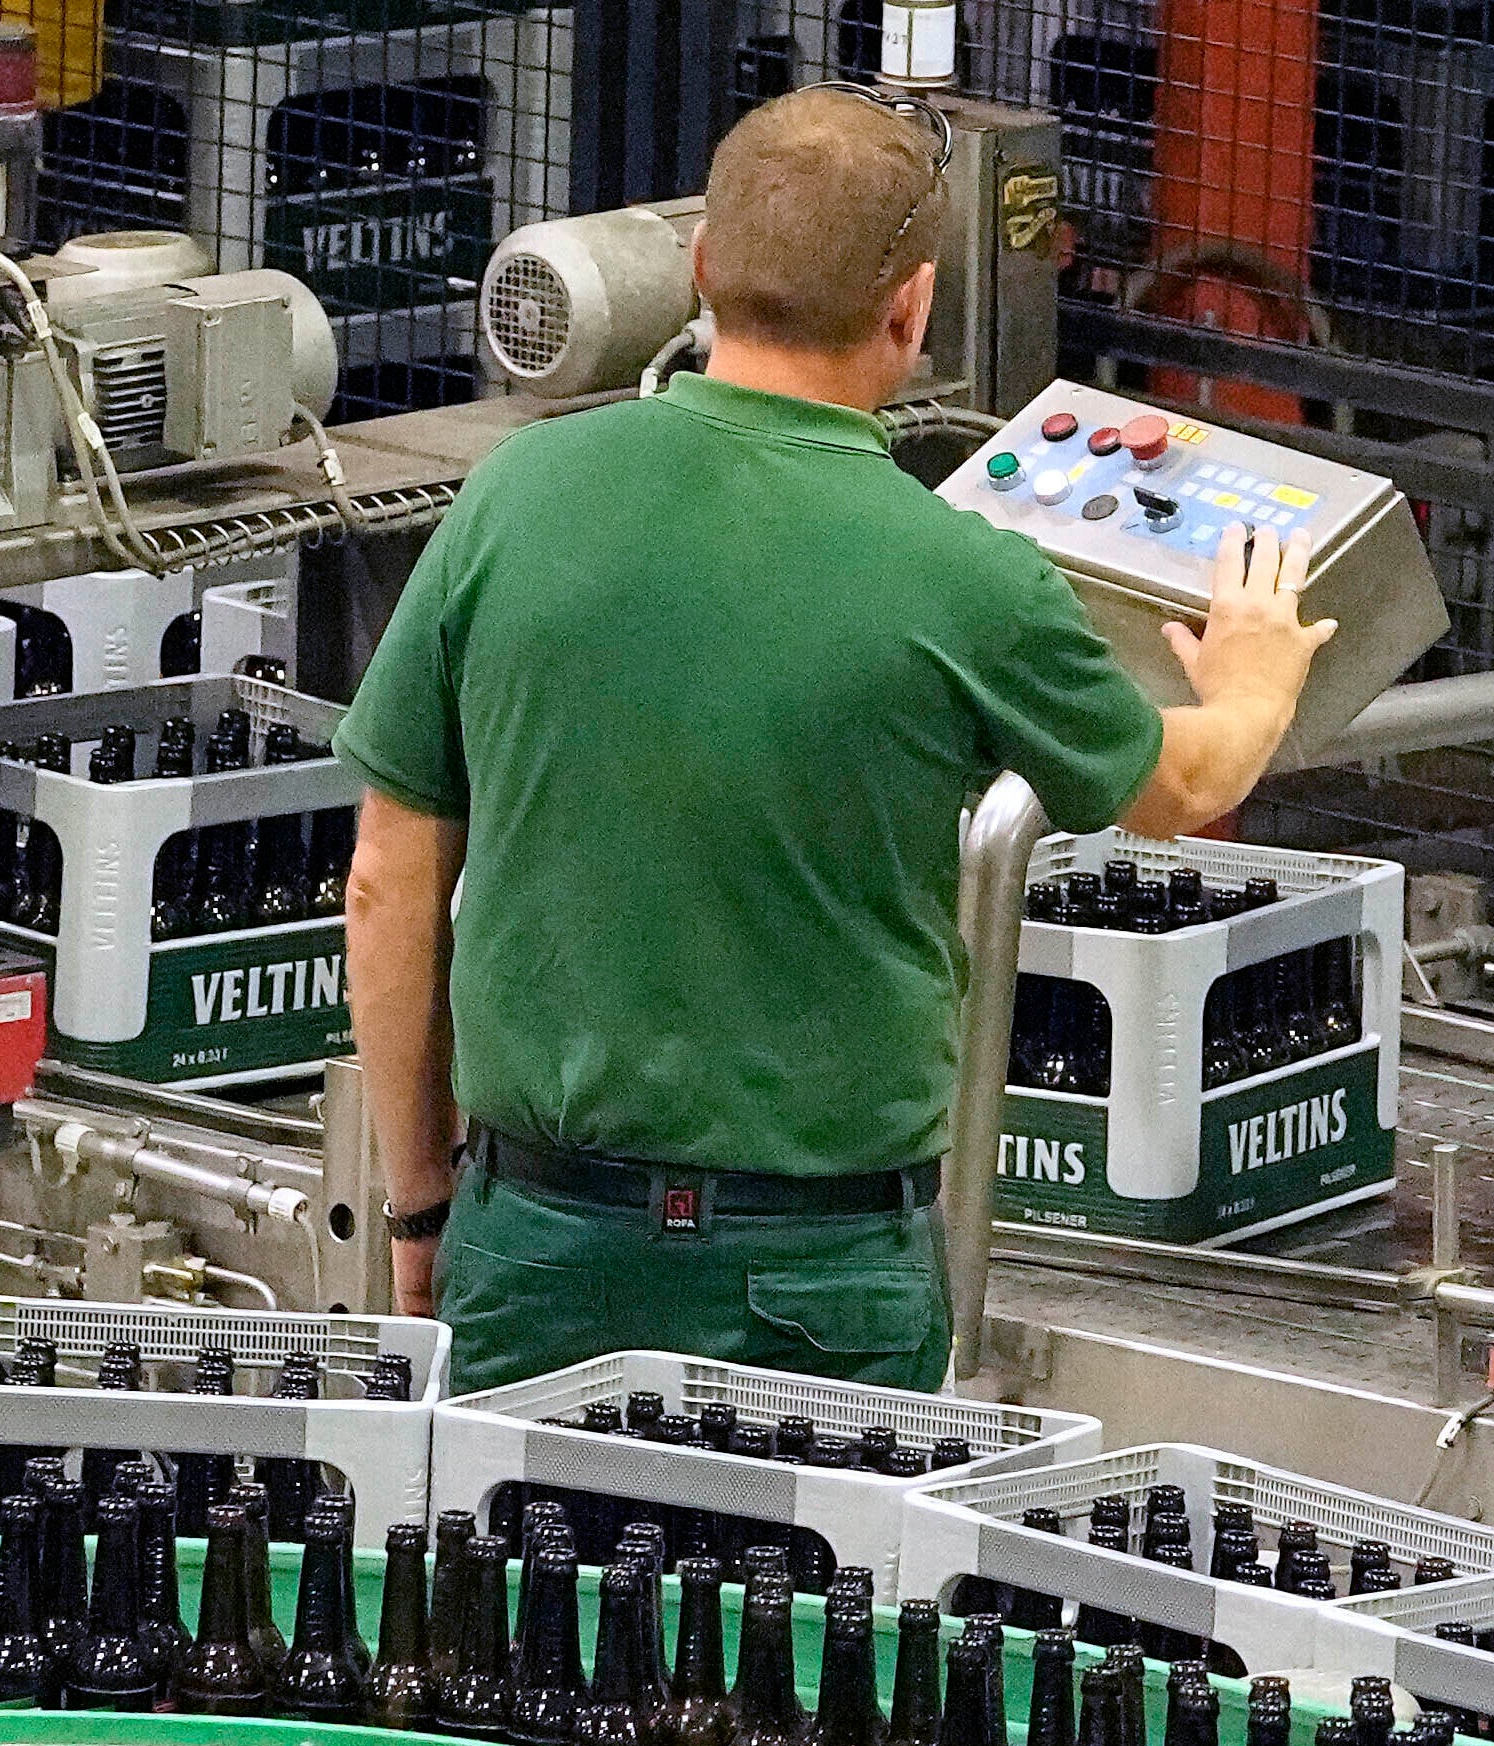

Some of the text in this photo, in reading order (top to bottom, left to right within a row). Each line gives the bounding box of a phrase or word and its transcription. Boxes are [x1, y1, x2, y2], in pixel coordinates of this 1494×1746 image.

[301, 211, 455, 271] VELTINS
[190, 953, 348, 1026] VELTIN
[1227, 1087, 1348, 1175] VELTINS
[1023, 1207, 1090, 1229] PILSENER
